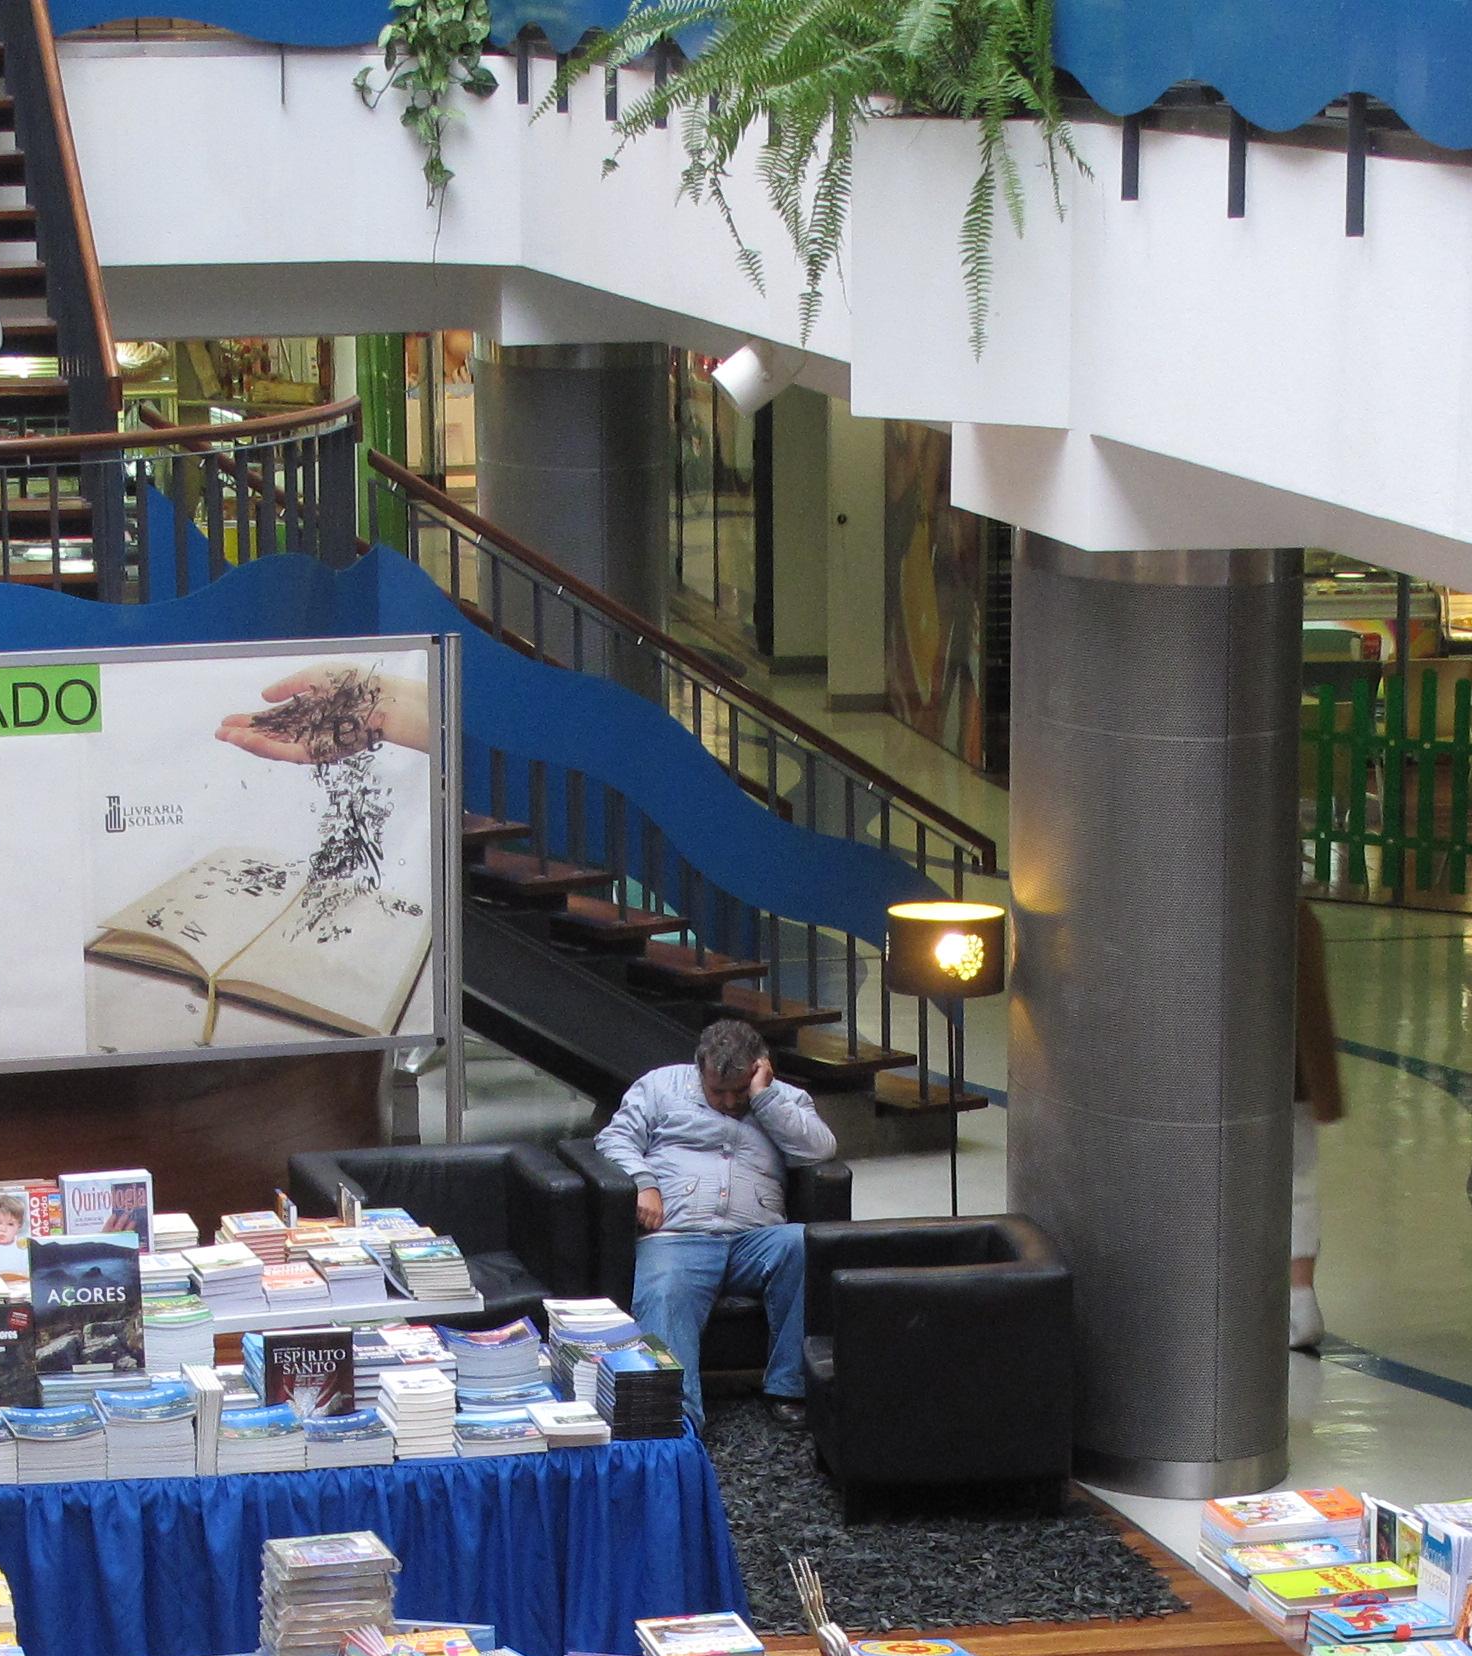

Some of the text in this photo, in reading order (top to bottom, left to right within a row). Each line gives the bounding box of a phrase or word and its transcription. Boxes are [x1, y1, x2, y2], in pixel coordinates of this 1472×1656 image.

[123, 804, 184, 816] LIVRARIA
[128, 815, 184, 828] SOLMAR
[71, 1181, 147, 1217] Quirologia
[48, 1286, 127, 1306] AÇORES
[273, 1348, 346, 1364] ESPÍRITO
[283, 1361, 337, 1375] SANTO
